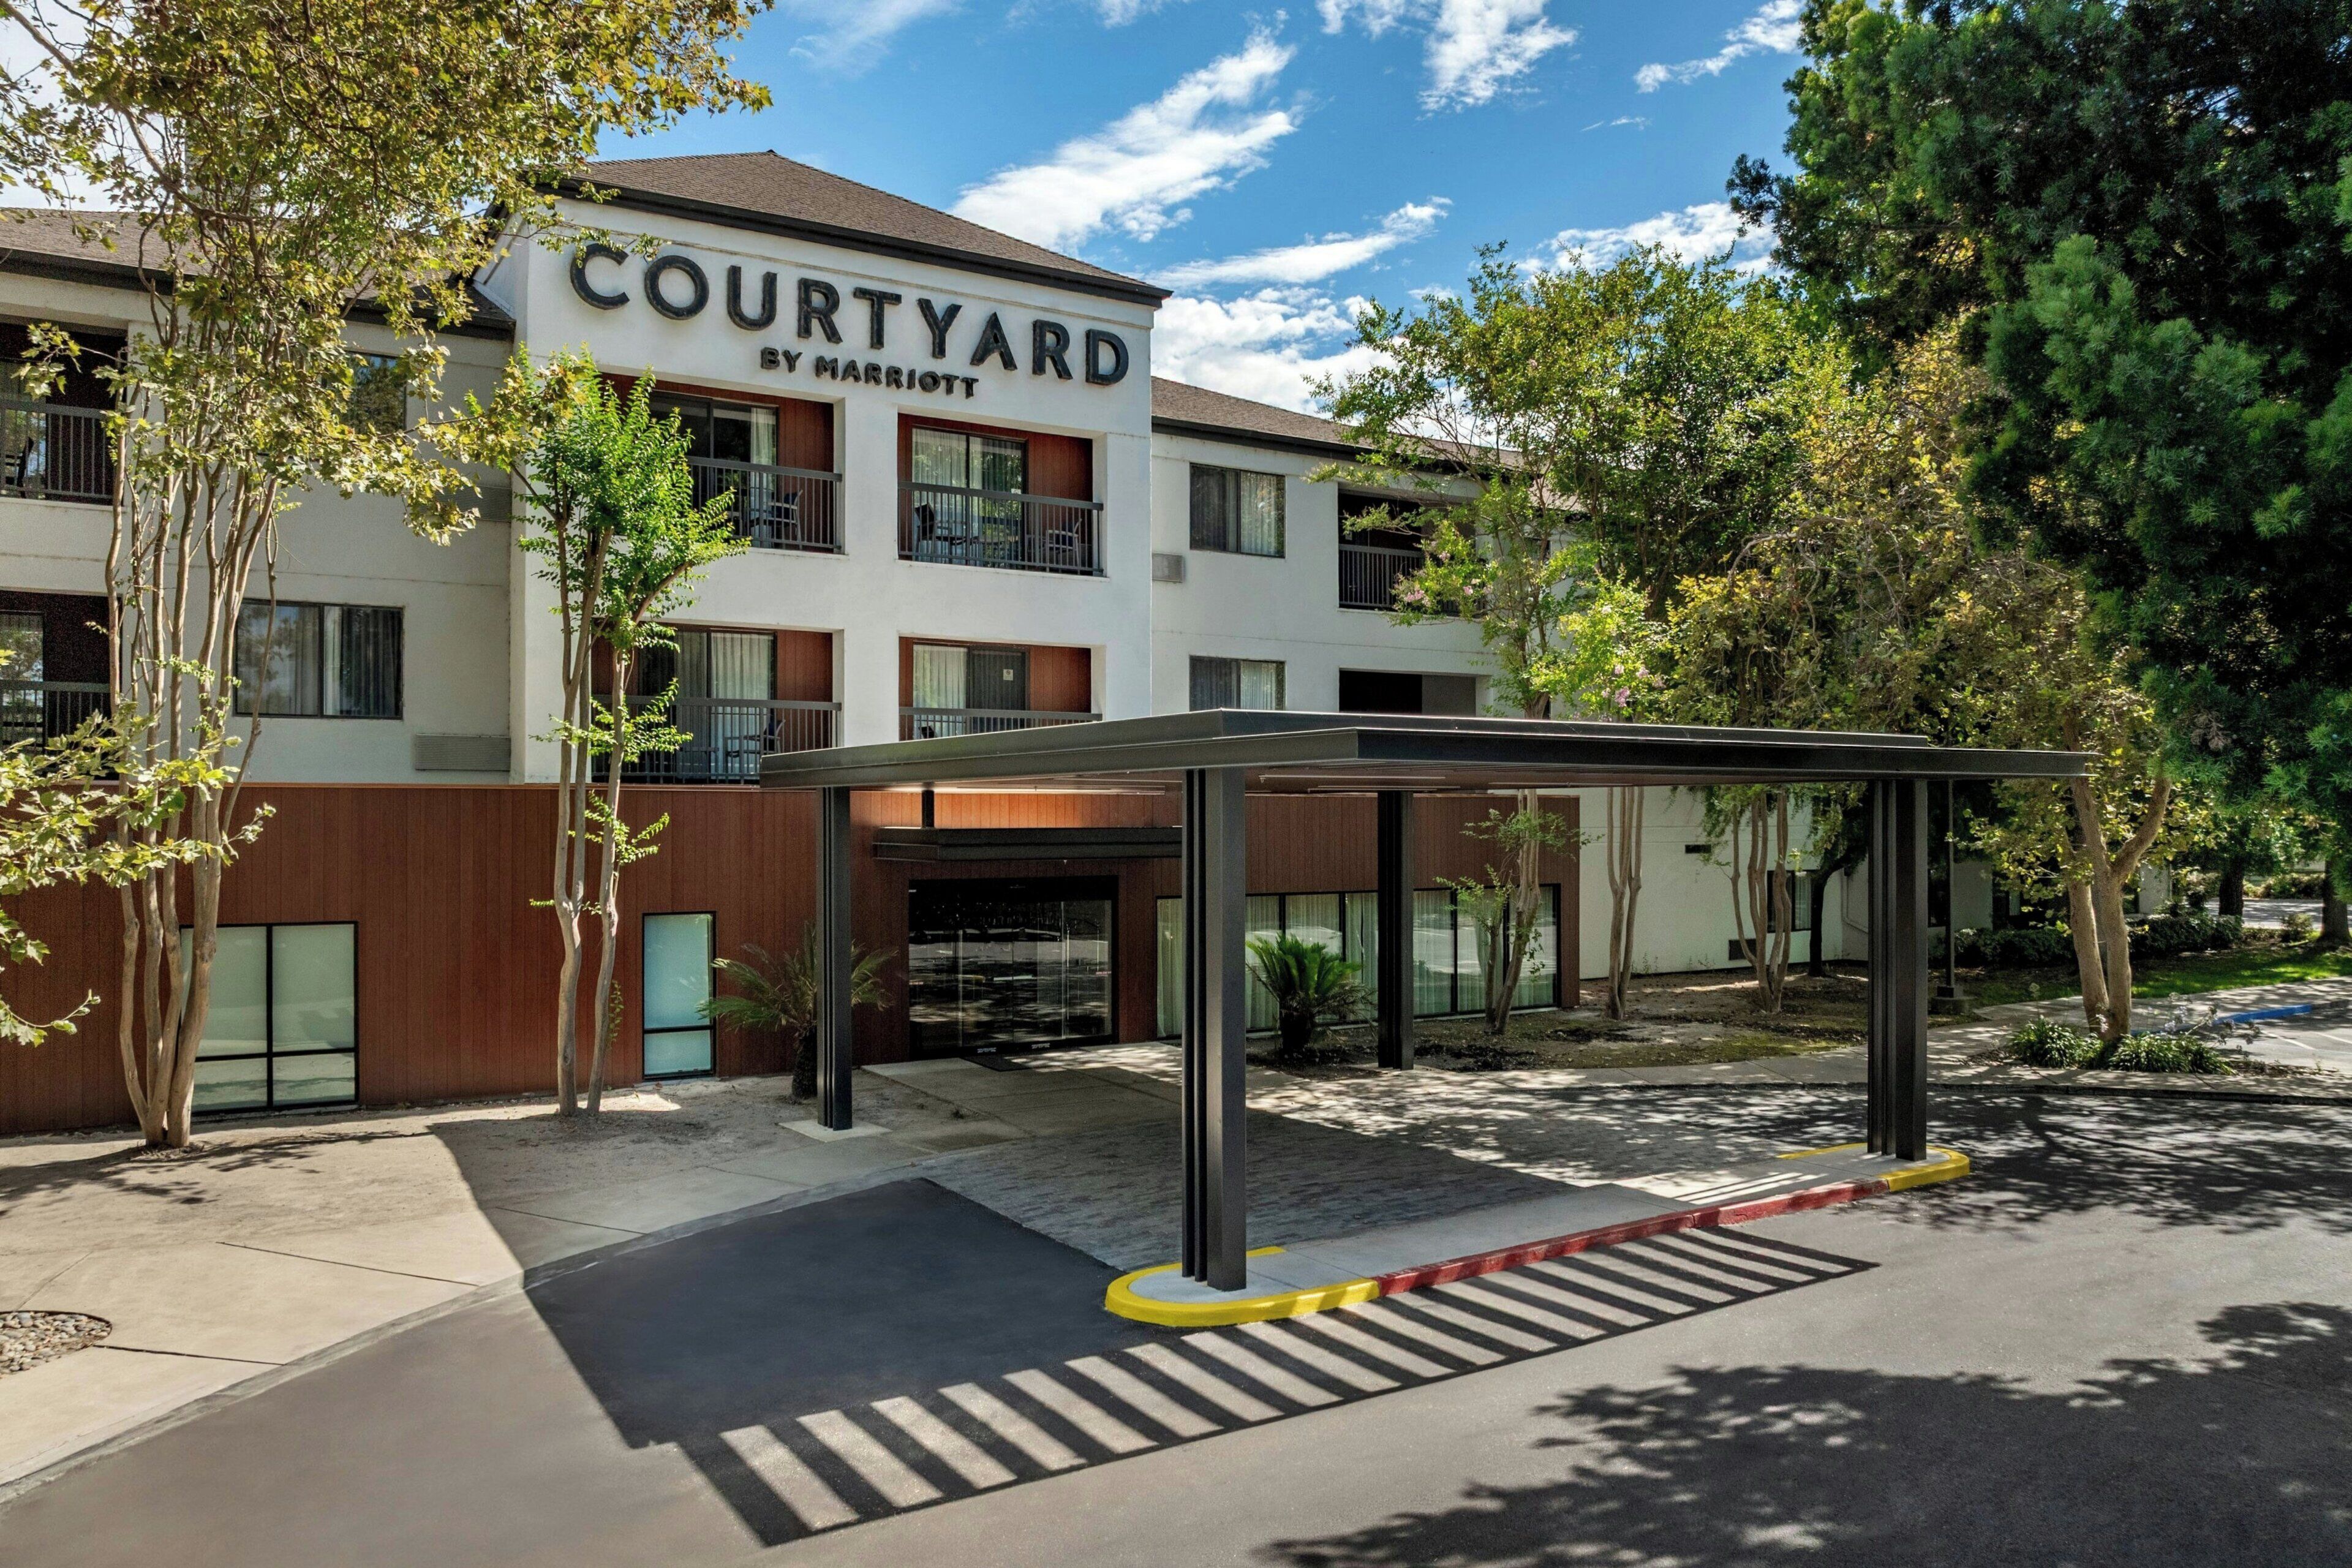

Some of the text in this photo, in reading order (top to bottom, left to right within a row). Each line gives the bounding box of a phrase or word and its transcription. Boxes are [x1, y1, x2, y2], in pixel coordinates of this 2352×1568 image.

[570, 243, 1129, 386] COURTYARD
[760, 347, 979, 399] BY MARRIOTT
